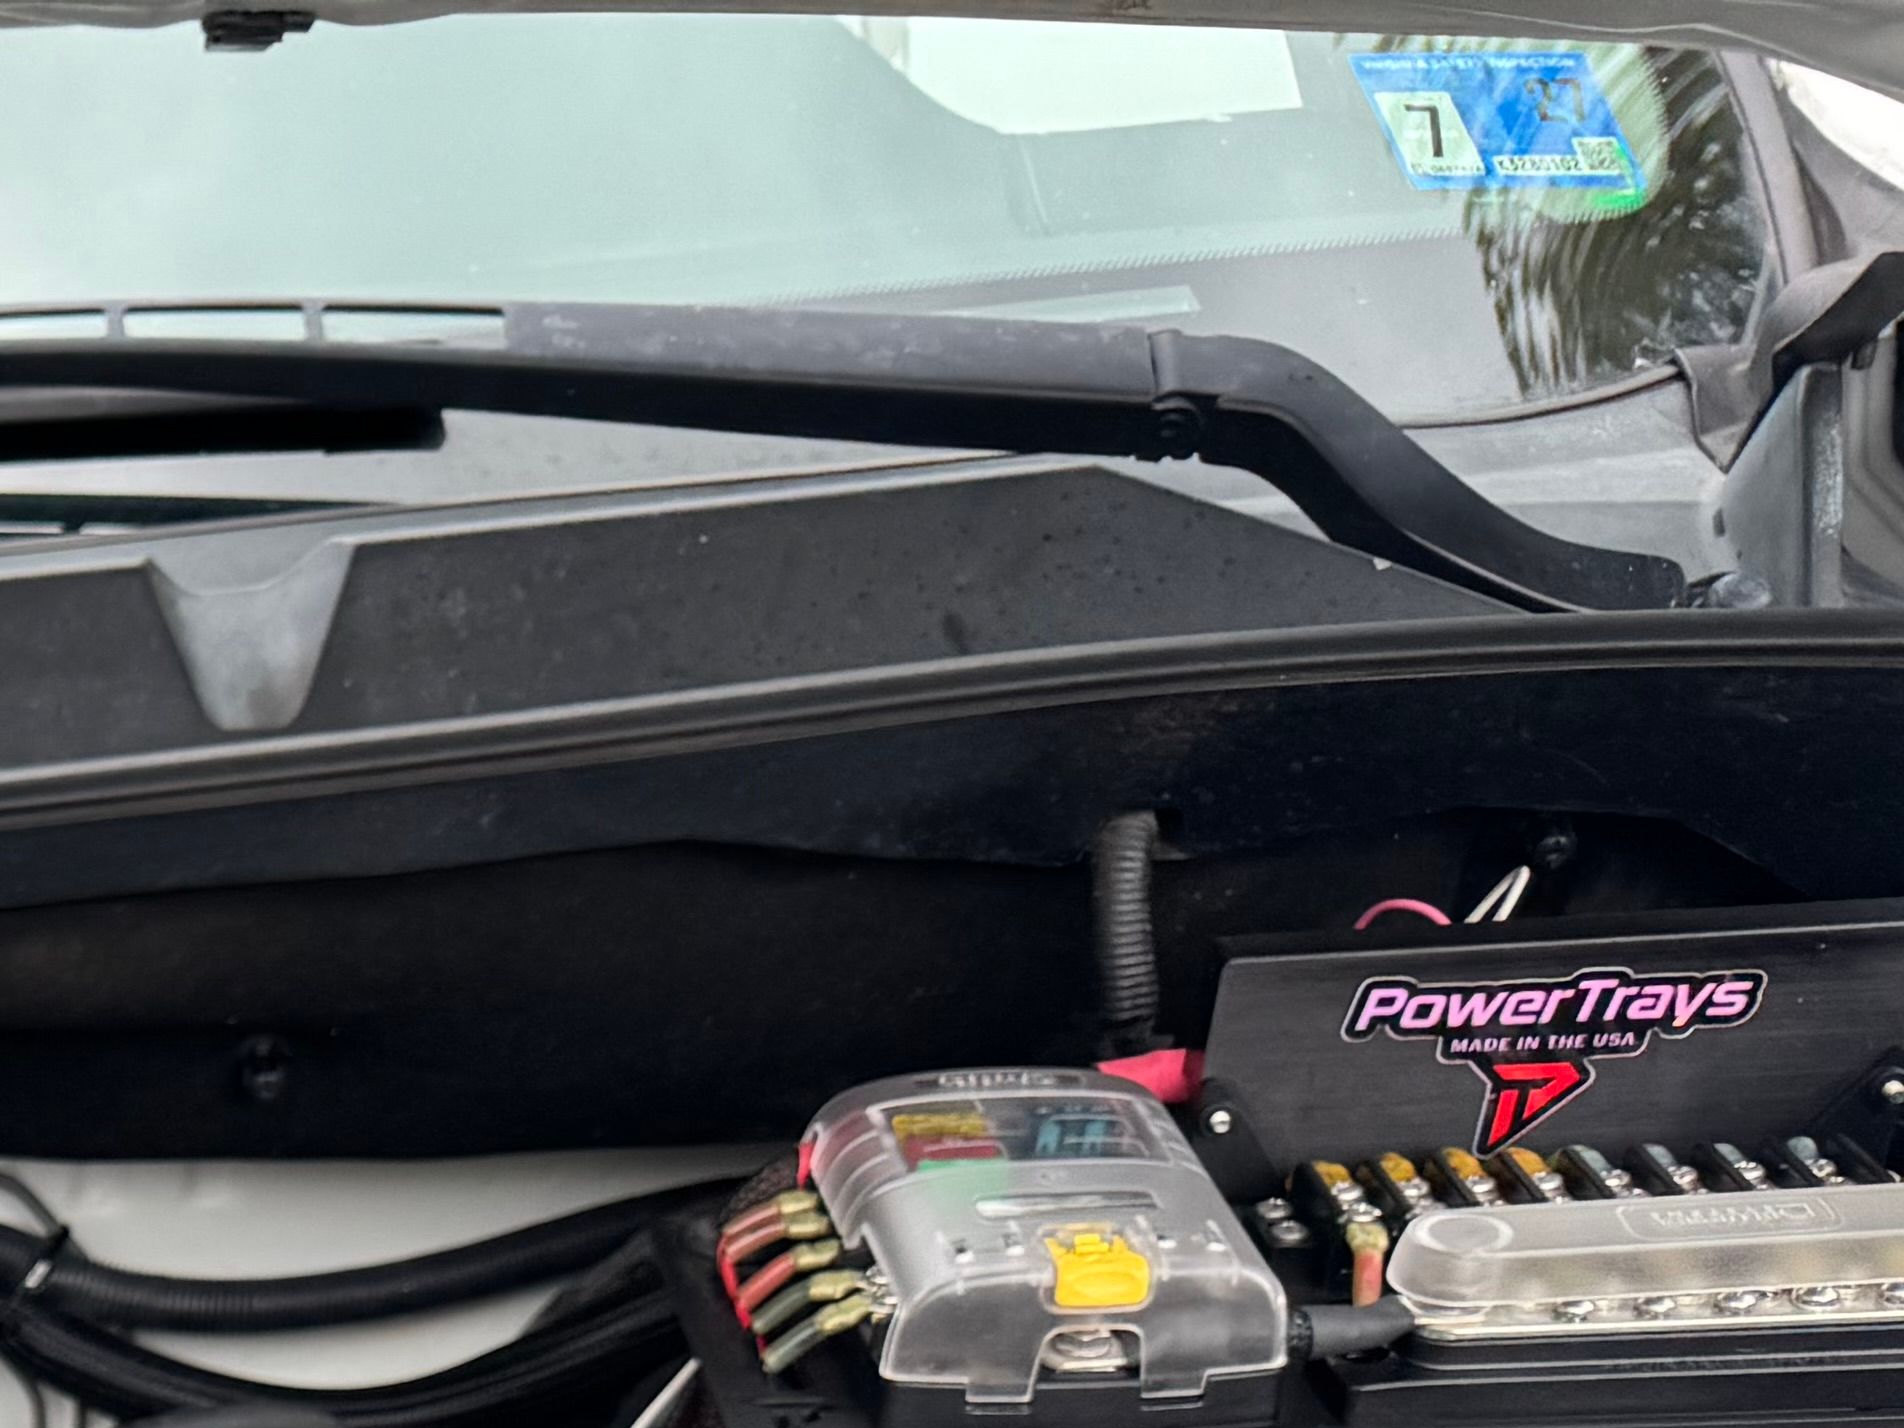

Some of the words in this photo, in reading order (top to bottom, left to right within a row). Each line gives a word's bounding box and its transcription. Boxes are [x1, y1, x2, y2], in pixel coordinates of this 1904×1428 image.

[1403, 103, 1444, 158] 7
[1353, 979, 1754, 1031] PowerTrays
[1450, 1038, 1511, 1053] MADE
[1517, 1037, 1540, 1050] IN
[1548, 1035, 1585, 1049] THE
[1593, 1032, 1637, 1048] USA
